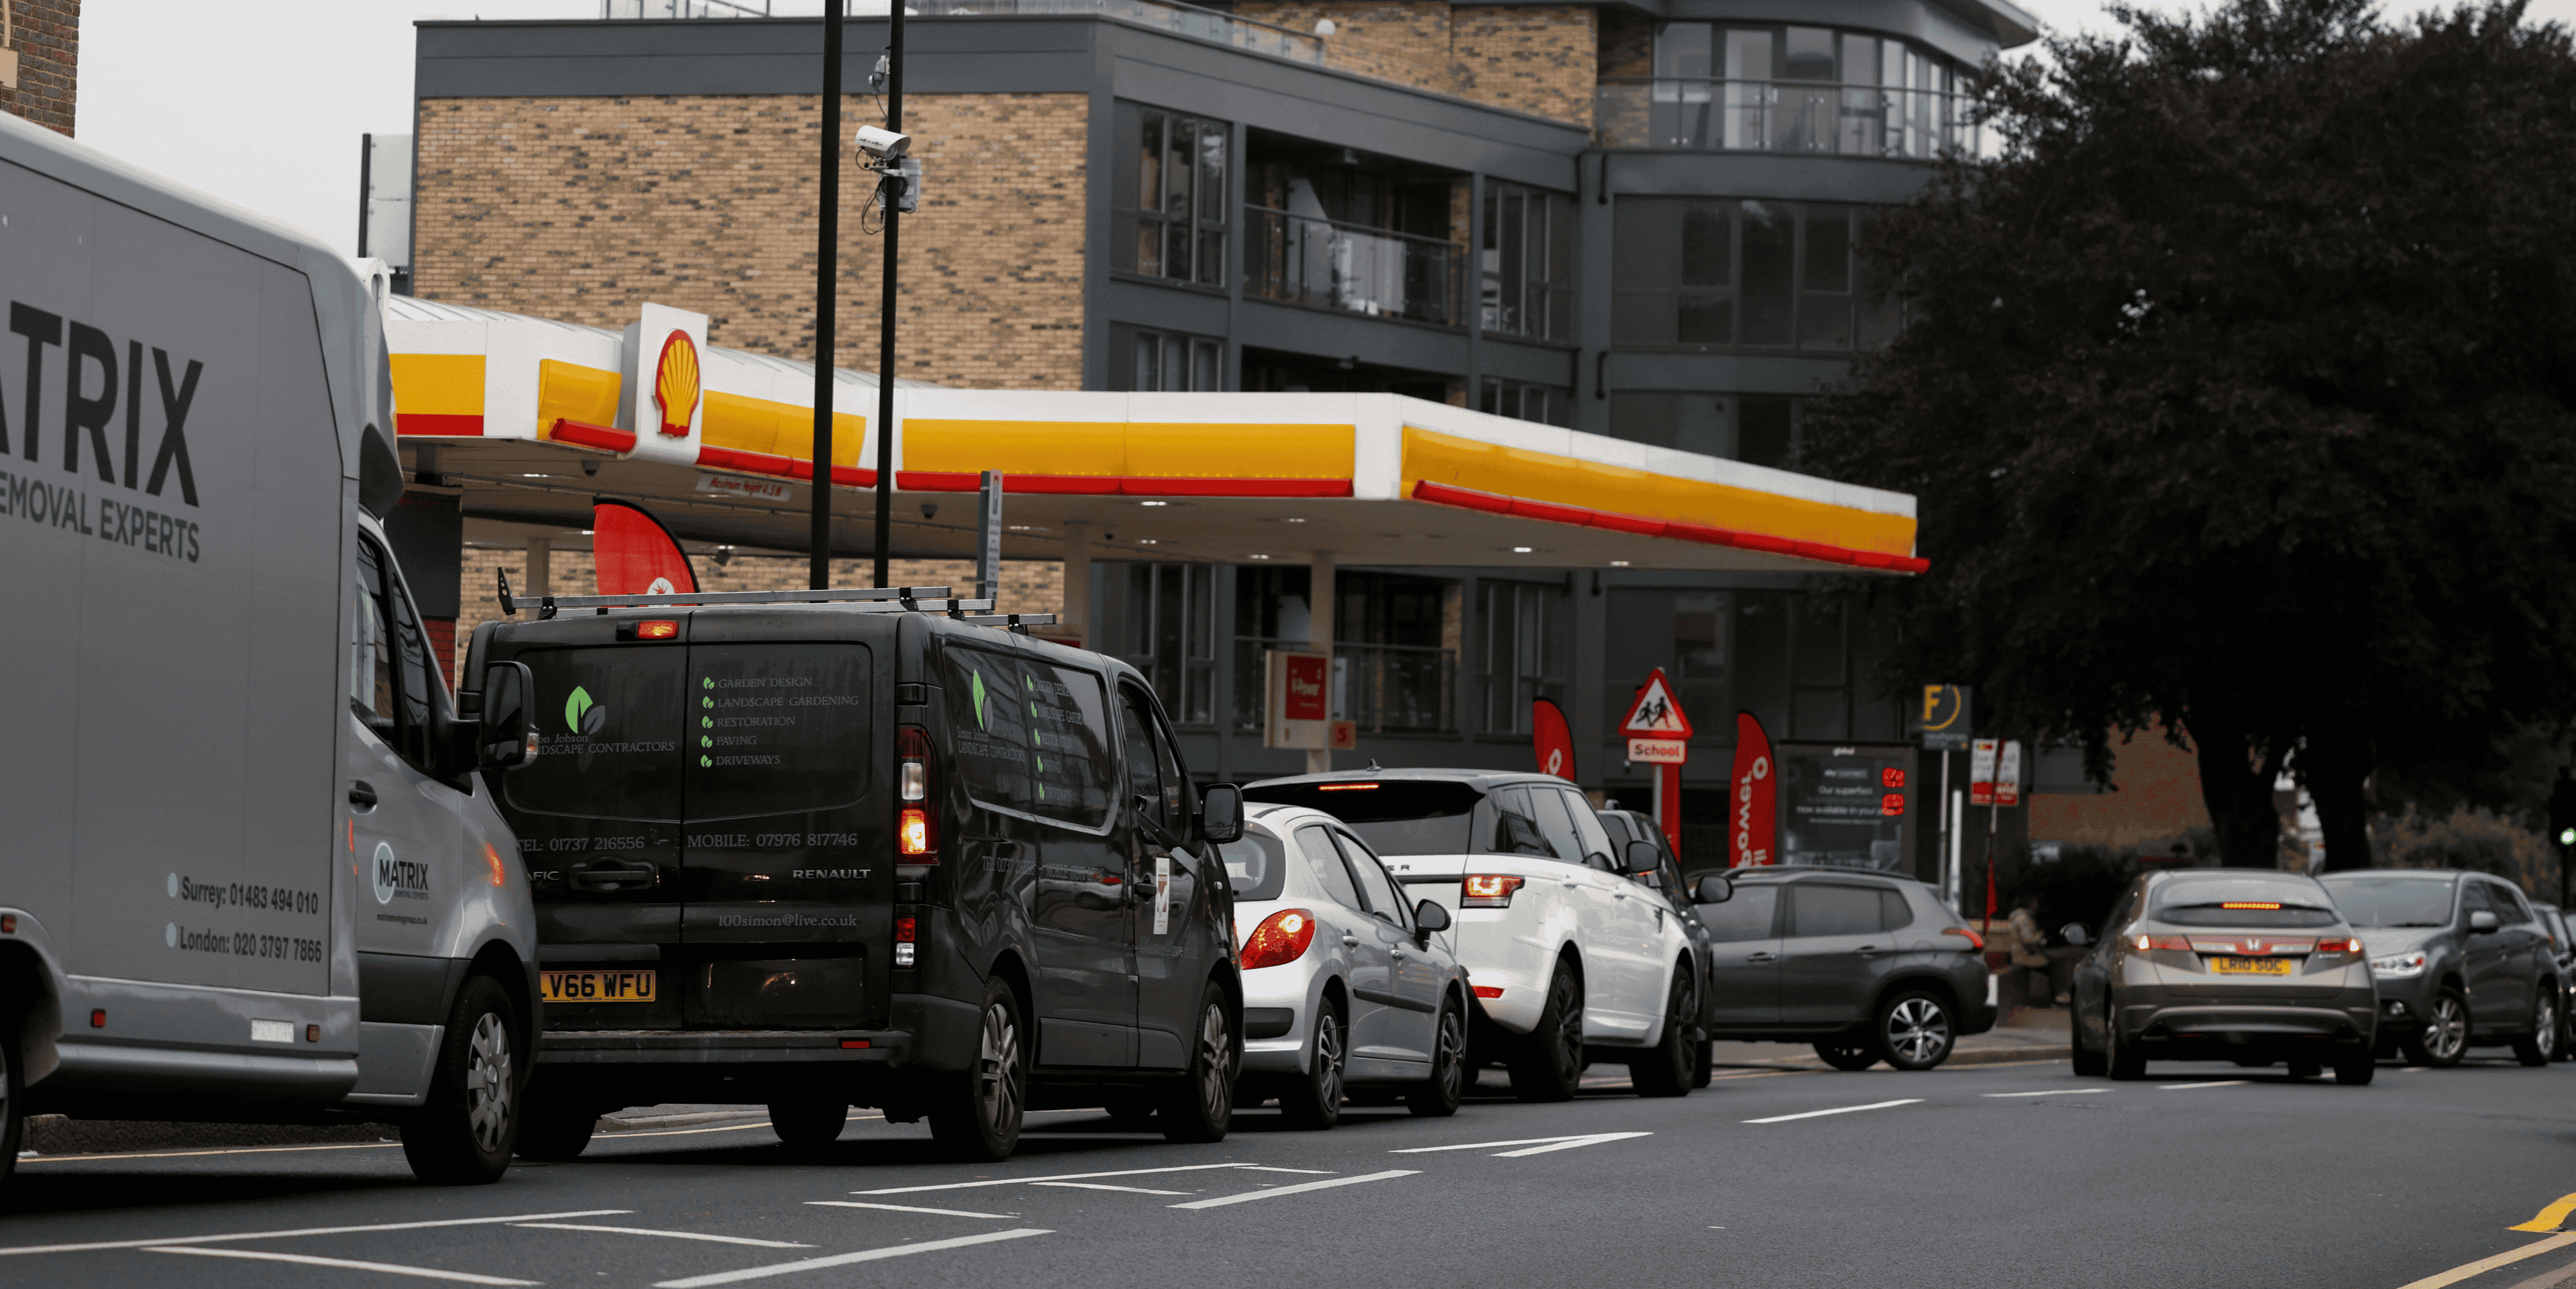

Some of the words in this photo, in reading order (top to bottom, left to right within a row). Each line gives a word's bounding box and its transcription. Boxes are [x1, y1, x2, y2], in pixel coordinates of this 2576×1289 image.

[0, 301, 204, 508] TRIX
[0, 470, 93, 536] EMOVAL
[99, 497, 200, 564] EXPERTS
[718, 678, 766, 688] GARDEN
[769, 677, 813, 688] DESIGN
[717, 697, 784, 708] LANDSCAPE
[788, 695, 859, 707] GARDENING
[716, 716, 796, 727] RESTORATION
[554, 733, 589, 744] Jobson
[716, 735, 757, 746] PAVING
[538, 743, 584, 756] NDSCAPE
[588, 741, 675, 754] CONTRACTORS
[1635, 743, 1680, 757] School
[715, 754, 782, 766] DRIVEWAYS
[549, 837, 589, 851] 01737
[594, 835, 645, 850] 216556
[687, 834, 750, 847] MOBILE:
[755, 833, 801, 847] 07976
[806, 832, 858, 846] 817746
[378, 858, 429, 890] MATRIX
[792, 868, 871, 880] RENAULT
[181, 876, 226, 909] Surrey:
[229, 882, 268, 909] 01483
[270, 888, 293, 912] 494
[297, 890, 319, 915] 010
[718, 913, 857, 927] 100simon@live.co.uk
[180, 925, 230, 954] London:
[233, 931, 257, 956] 020
[260, 934, 289, 960] 3797
[293, 937, 322, 963] 7866
[542, 974, 596, 998] V66
[603, 974, 651, 998] WFU
